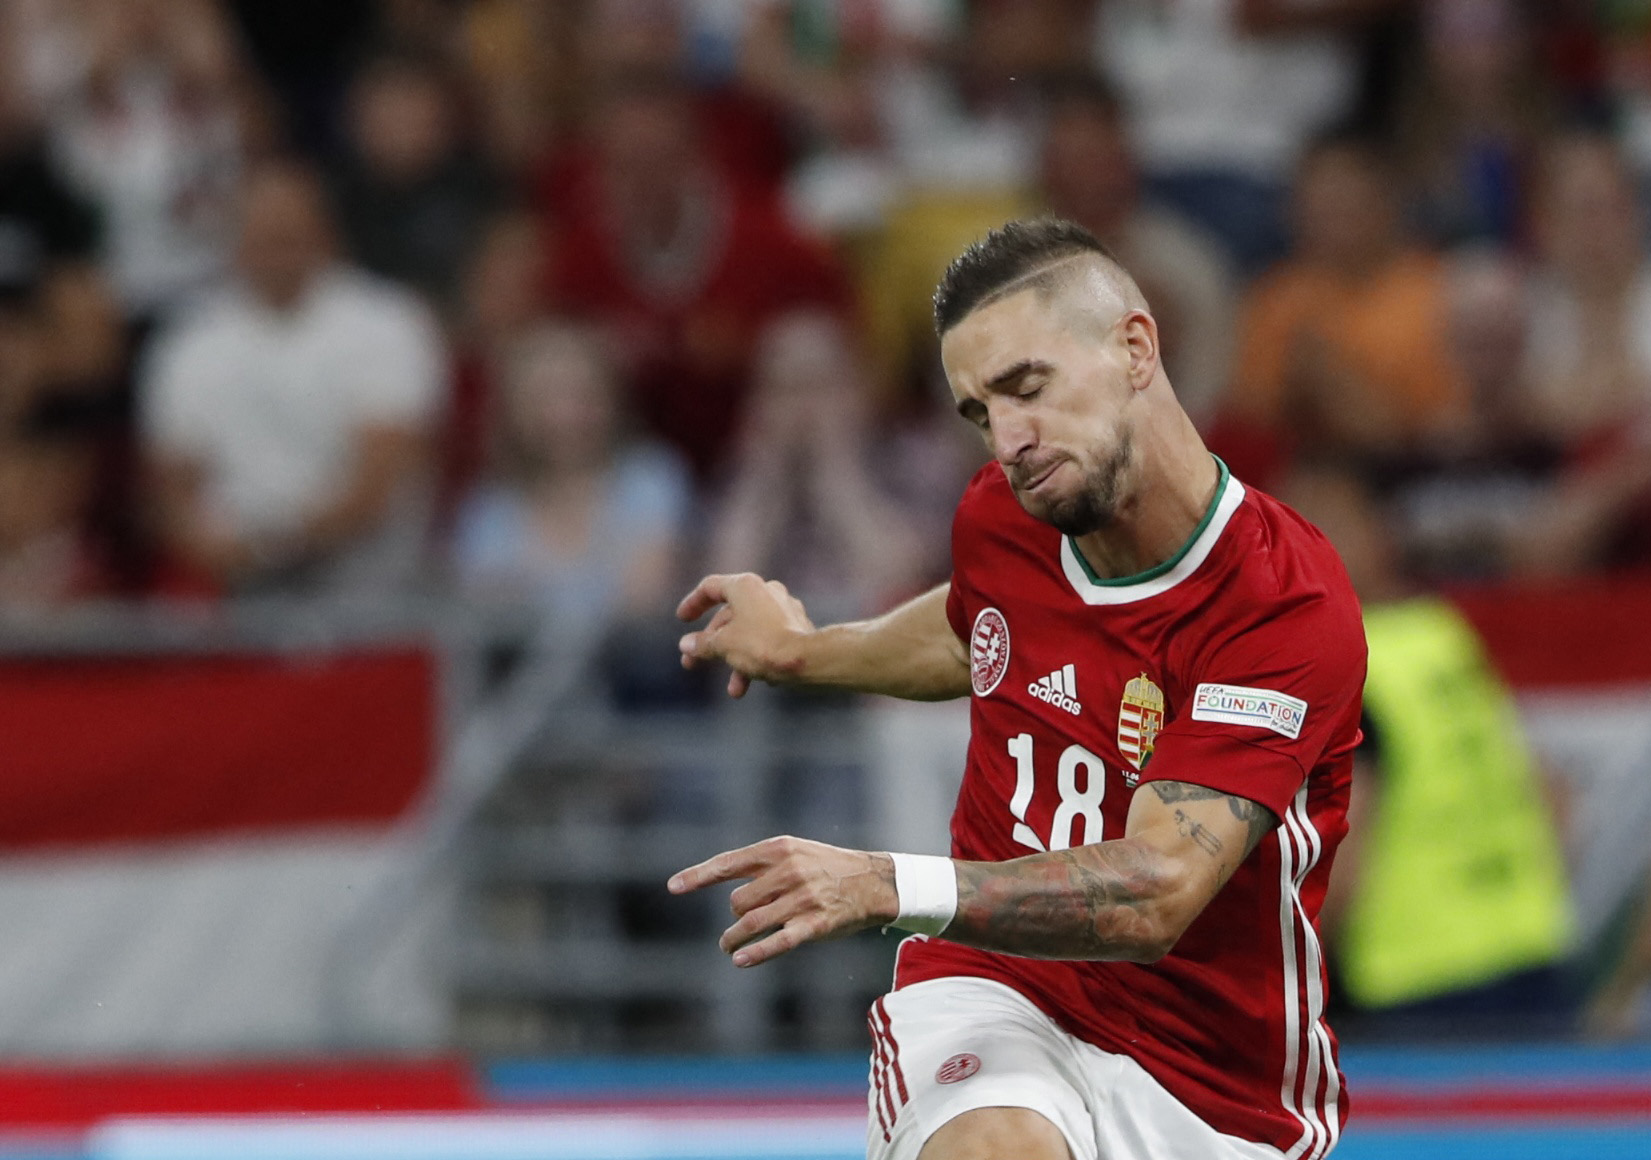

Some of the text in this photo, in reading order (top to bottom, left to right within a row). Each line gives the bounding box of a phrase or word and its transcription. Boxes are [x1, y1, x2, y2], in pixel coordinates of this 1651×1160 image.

[1028, 682, 1082, 716] adidas
[1199, 685, 1224, 695] UEFA
[1197, 694, 1302, 725] FOUNDATION
[1008, 733, 1105, 852] 18
